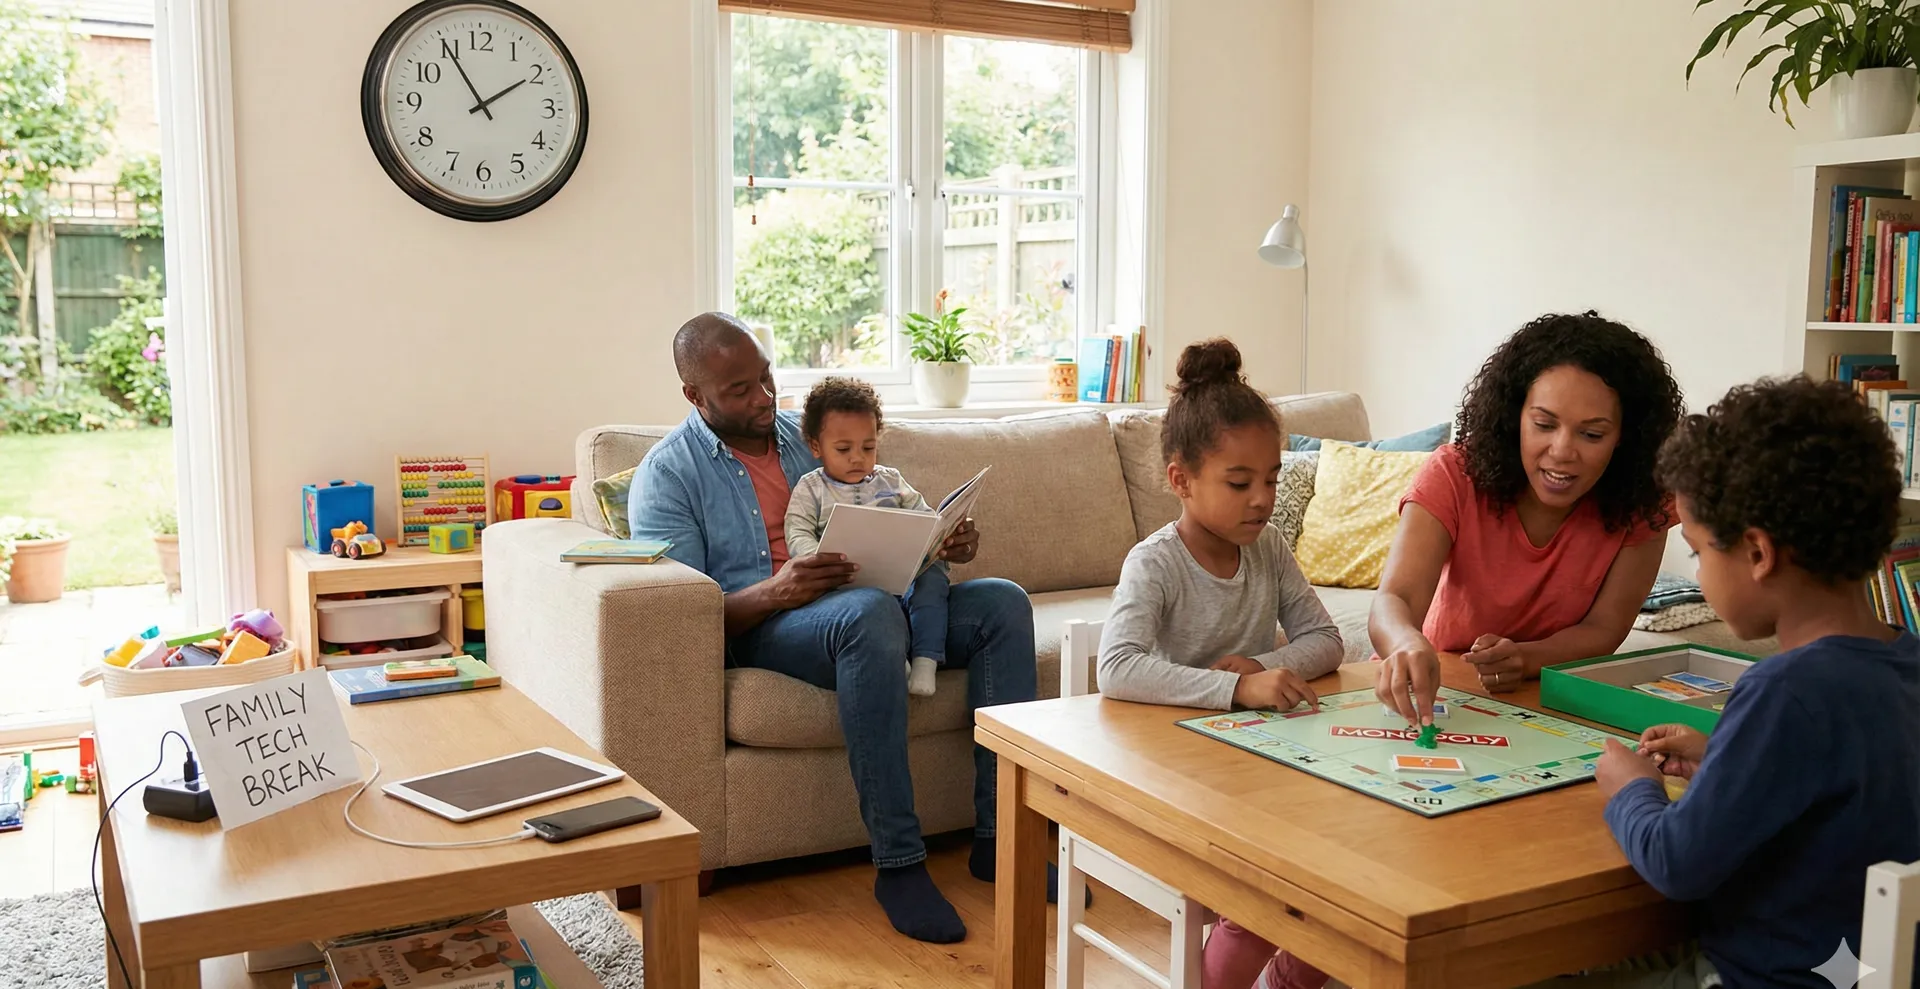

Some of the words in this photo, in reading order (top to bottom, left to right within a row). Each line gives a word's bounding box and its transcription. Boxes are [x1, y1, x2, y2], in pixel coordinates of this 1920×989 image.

[440, 38, 461, 60] 11
[468, 31, 494, 52] 12
[509, 41, 518, 62] 1
[416, 62, 441, 84] 10
[529, 64, 544, 85] 2
[406, 91, 422, 114] 9
[541, 98, 556, 119] 3
[418, 126, 434, 147] 8
[531, 130, 546, 150] 4
[446, 151, 460, 171] 7
[476, 160, 491, 182] 6
[510, 153, 525, 174] 5
[205, 682, 307, 737] FAMILY
[235, 723, 308, 764] TECH
[242, 752, 336, 807] BREAK
